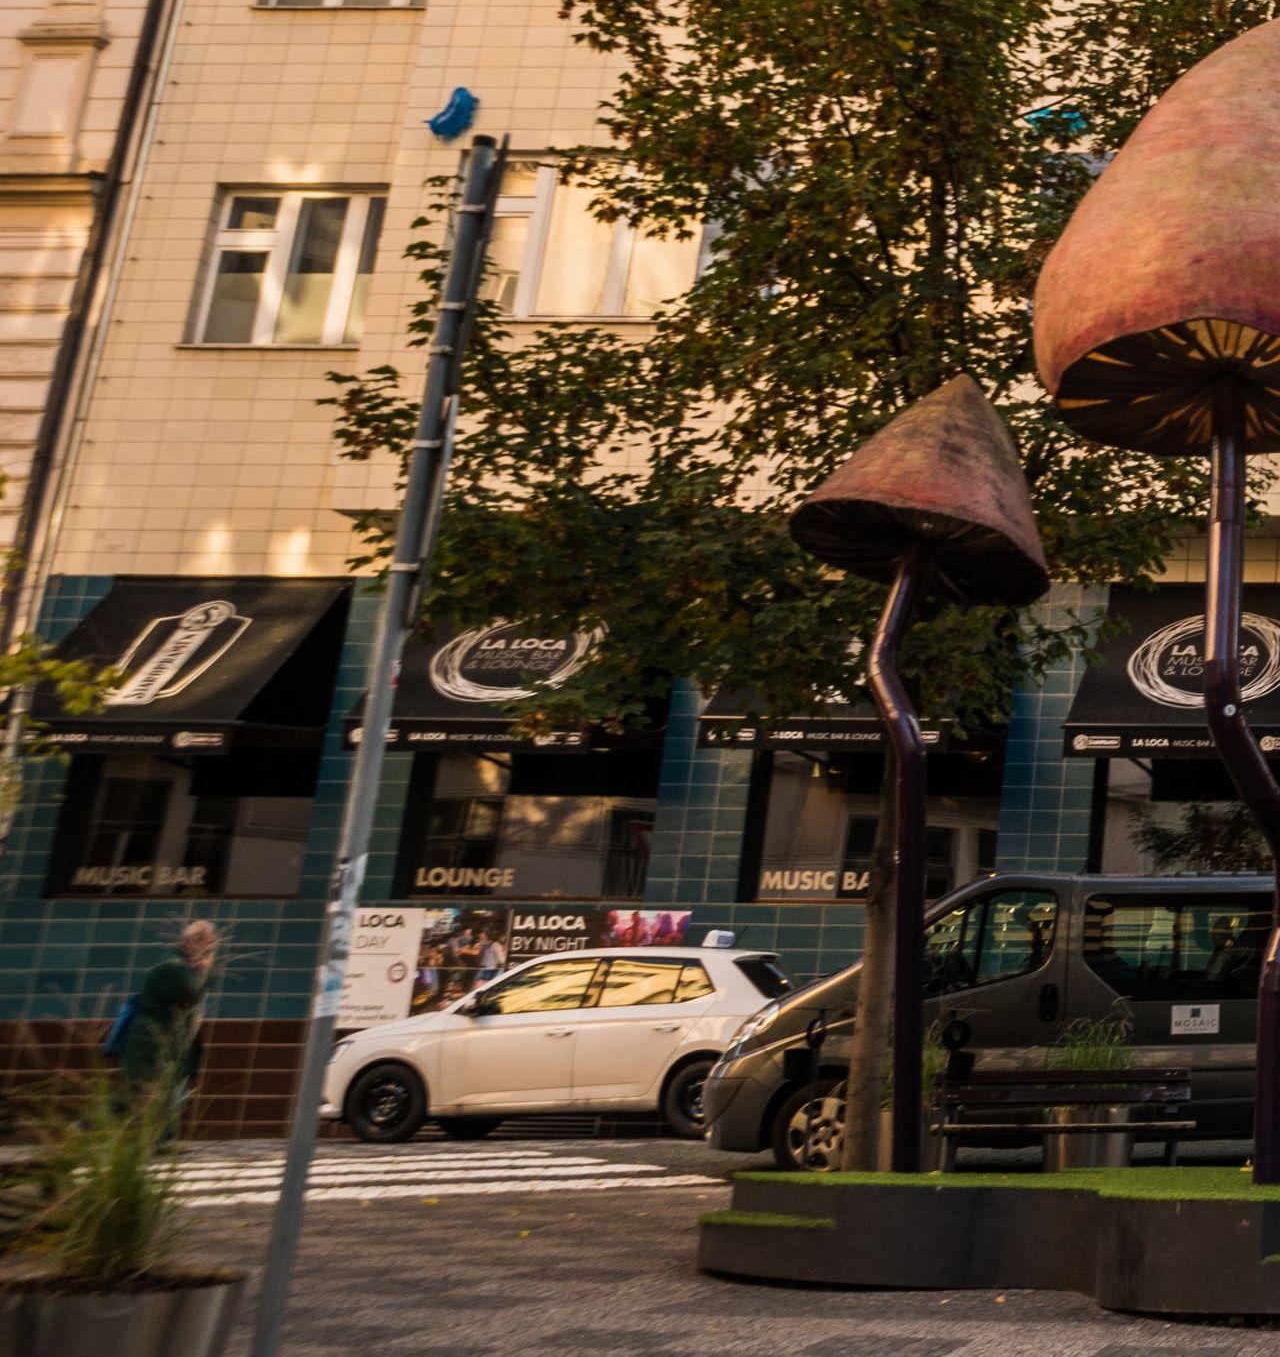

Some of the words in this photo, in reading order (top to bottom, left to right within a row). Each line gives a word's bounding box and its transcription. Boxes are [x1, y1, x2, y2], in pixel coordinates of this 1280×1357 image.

[480, 638, 506, 650] LA
[511, 638, 567, 650] LOCA
[1171, 644, 1198, 656] LA
[471, 650, 525, 660] MUSIC
[531, 650, 563, 660] BAR
[484, 660, 556, 670] LOUNGE
[779, 731, 804, 741] LOCA
[1132, 738, 1144, 747] LA
[1145, 738, 1170, 747] LOCA
[71, 866, 150, 886] MUSIC
[158, 866, 207, 886] BAR
[415, 867, 515, 888] LOUNGE
[760, 870, 836, 891] MUSIC
[842, 870, 871, 891] BA
[360, 914, 405, 928] LOCA
[513, 914, 538, 929] LA
[539, 914, 586, 929] LOCA
[356, 935, 391, 949] DAY
[511, 936, 532, 950] BY
[536, 935, 590, 951] NIGHT
